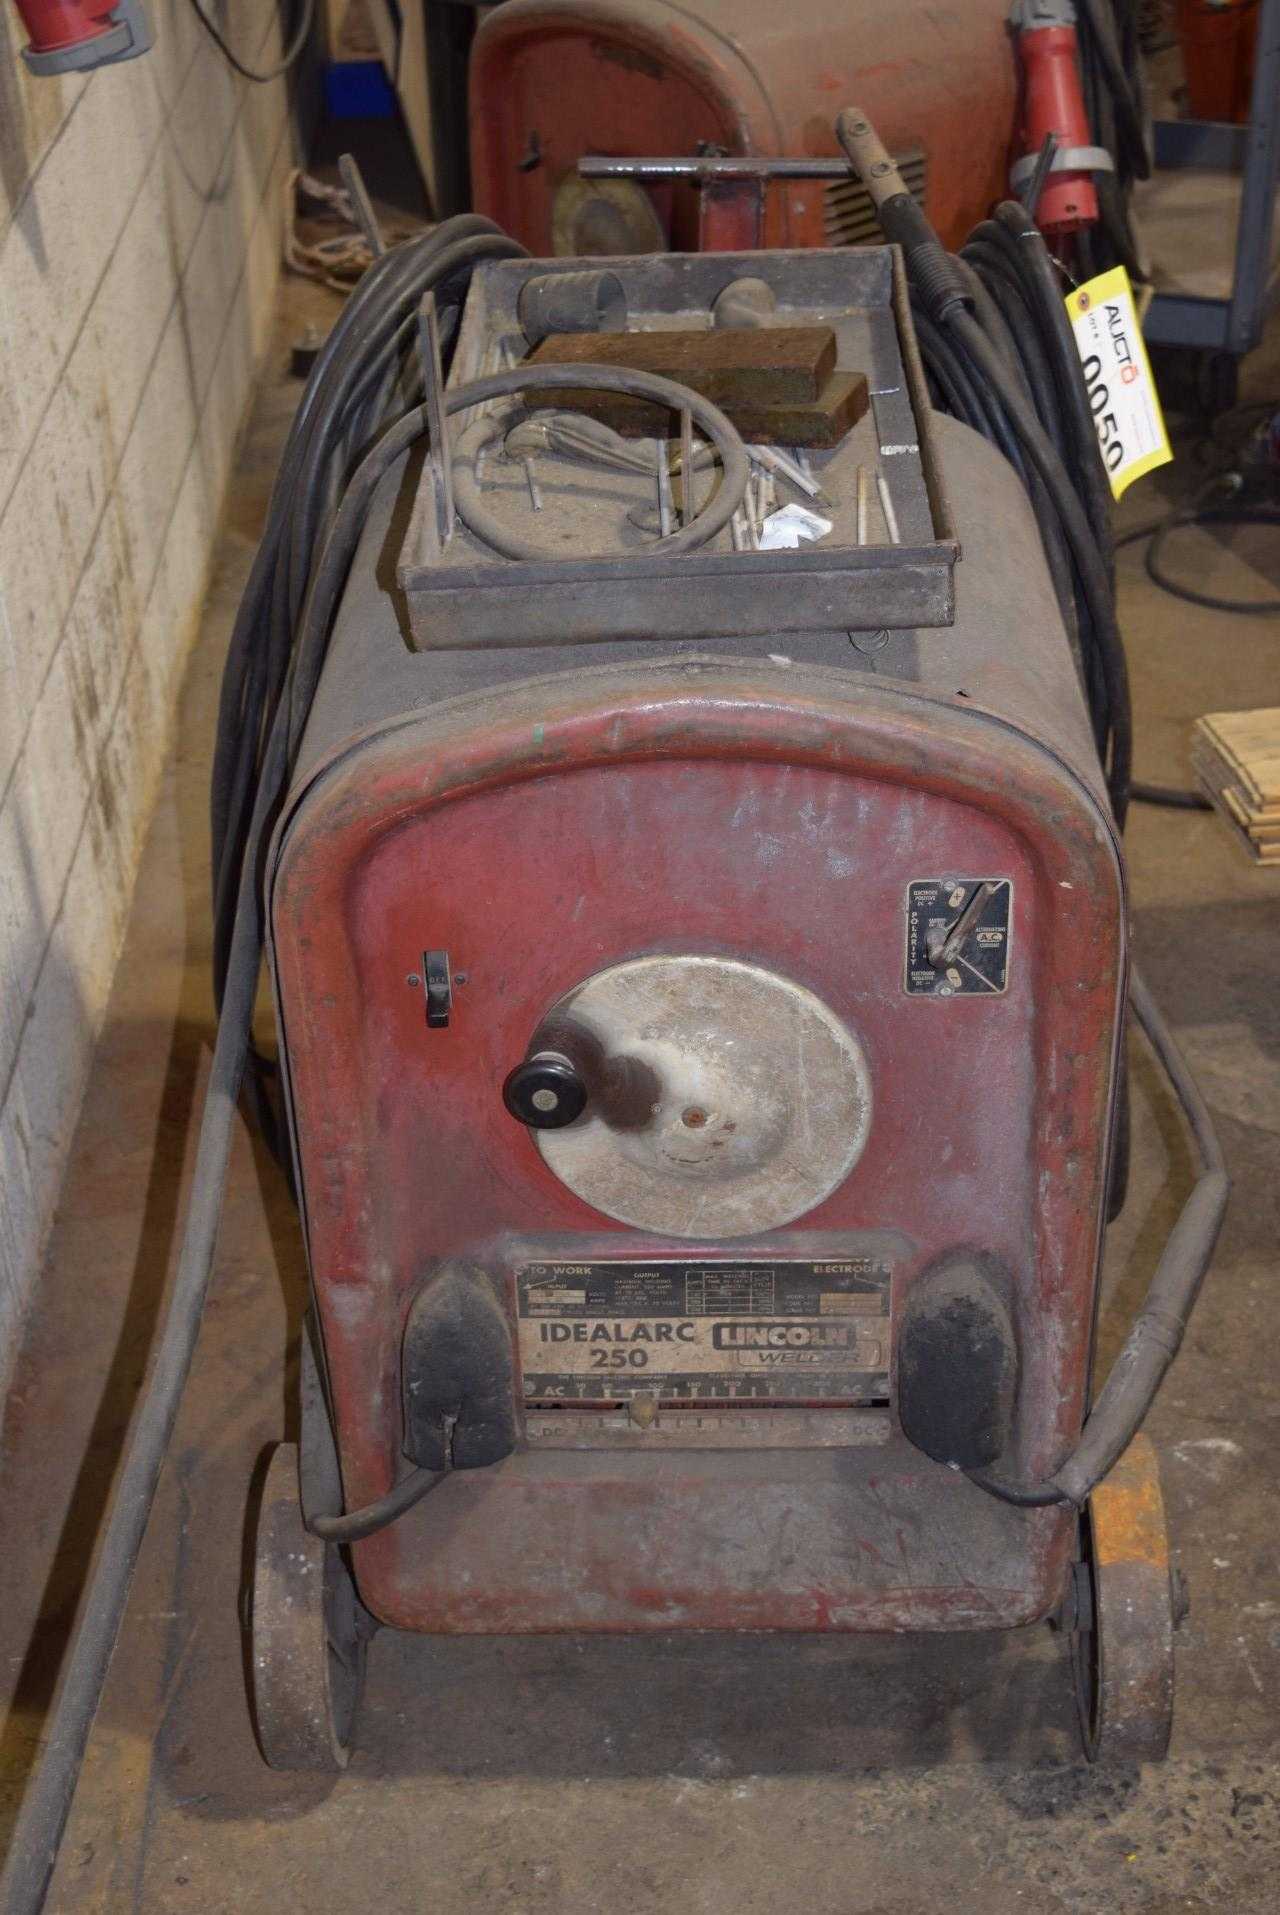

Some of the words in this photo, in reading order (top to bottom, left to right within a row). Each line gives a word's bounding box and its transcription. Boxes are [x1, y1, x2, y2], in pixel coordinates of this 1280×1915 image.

[1082, 354, 1124, 472] 0050
[910, 911, 919, 966] POLARITY
[530, 1266, 547, 1275] TO
[552, 1266, 593, 1275] WORK
[813, 1264, 879, 1274] ELECTRODE
[540, 1322, 695, 1343] IDEALARC
[720, 1326, 848, 1346] LINCOLN
[590, 1348, 649, 1368] 250
[758, 1351, 860, 1364] WELDER
[543, 1385, 565, 1396] AC
[840, 1384, 863, 1394] AC
